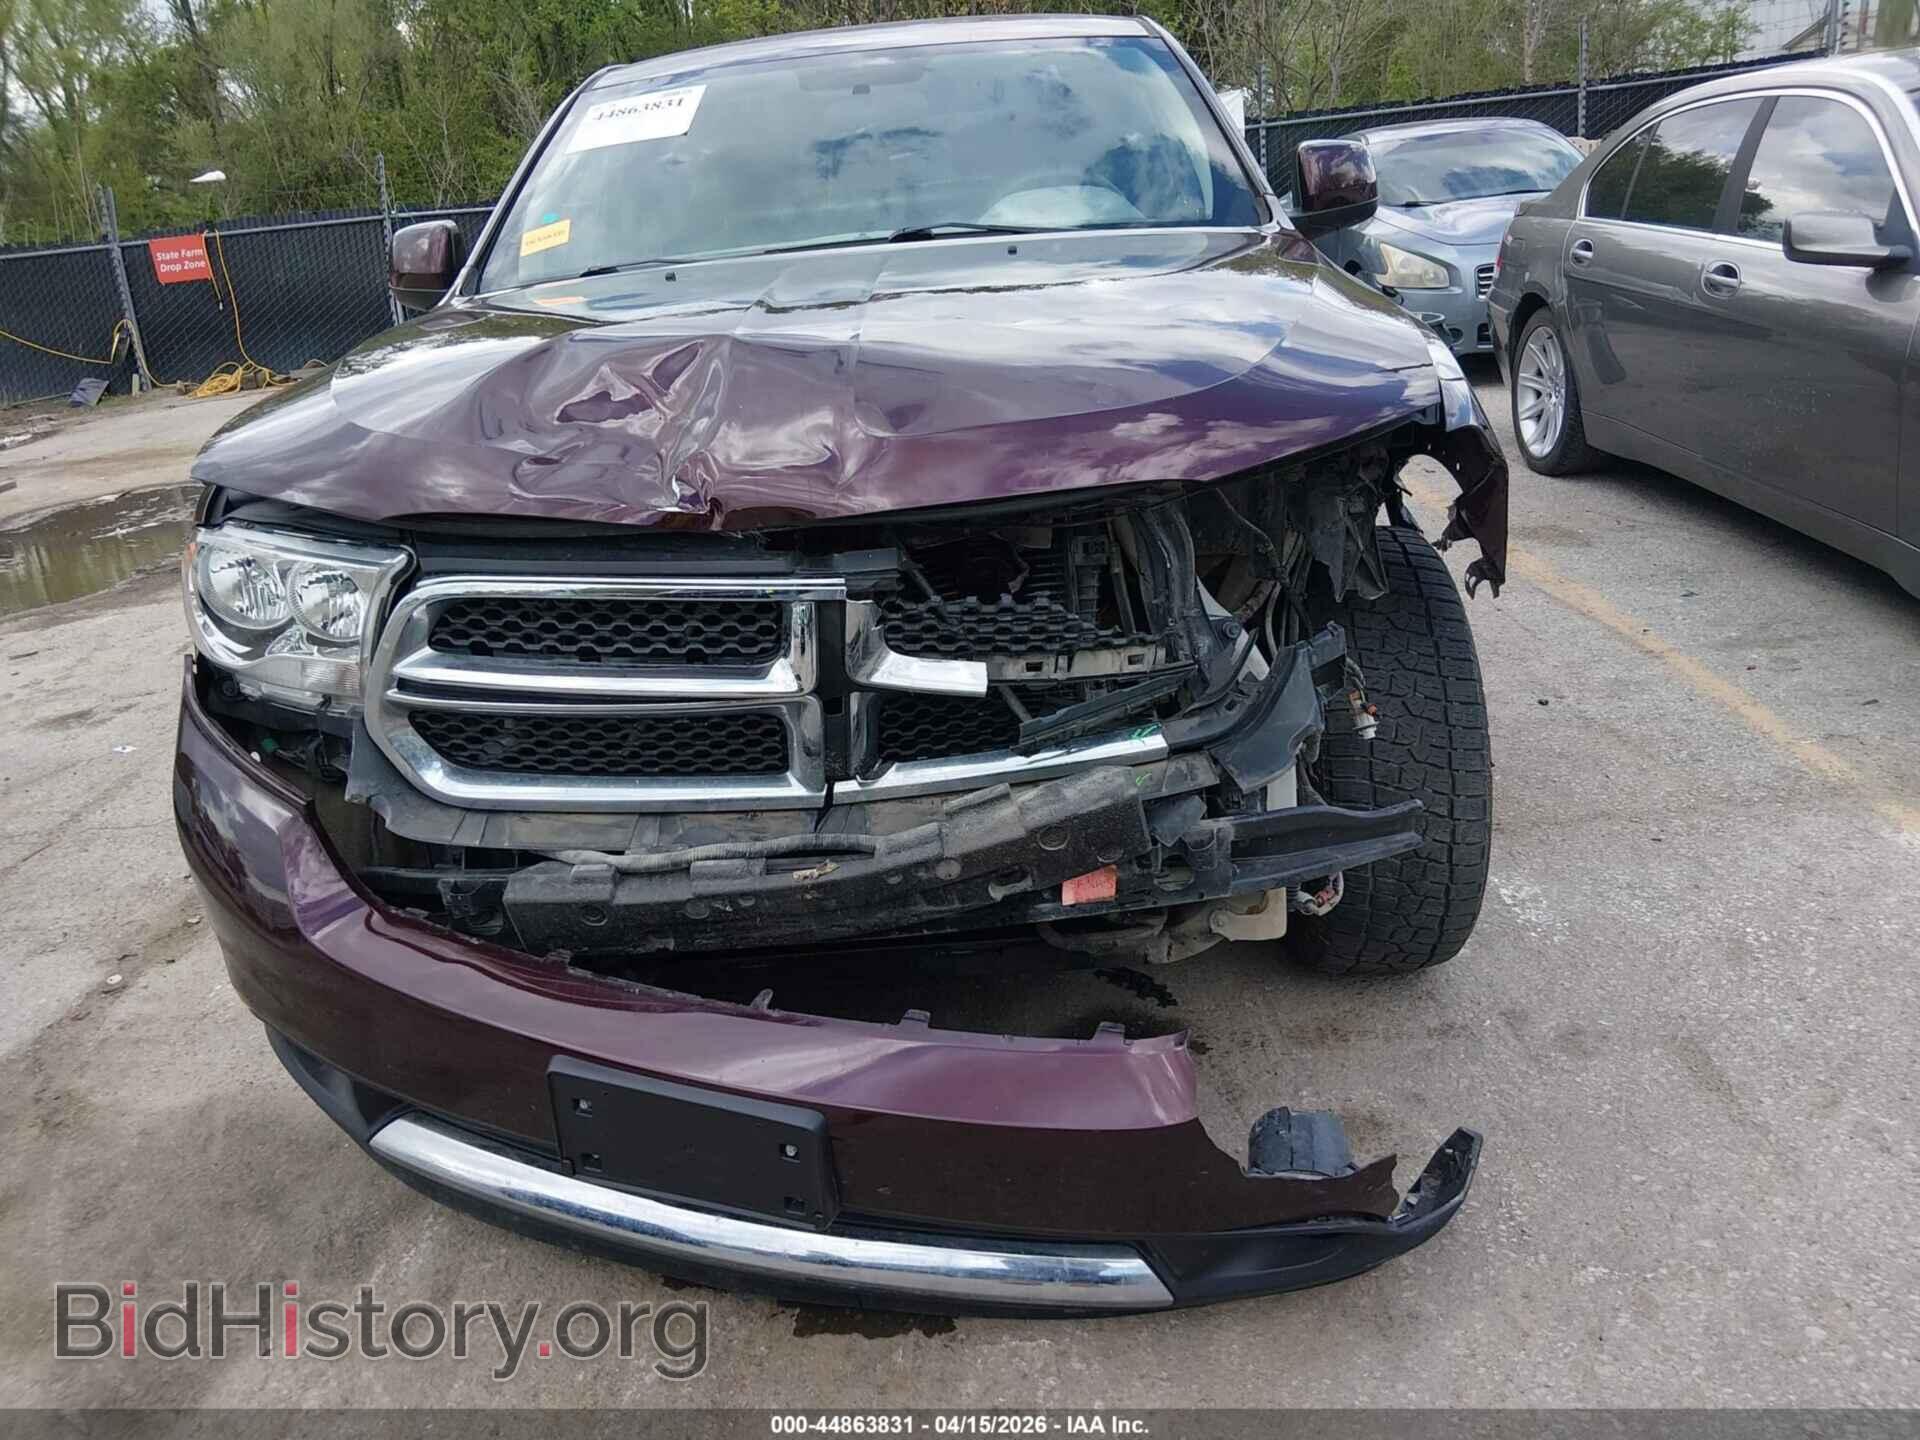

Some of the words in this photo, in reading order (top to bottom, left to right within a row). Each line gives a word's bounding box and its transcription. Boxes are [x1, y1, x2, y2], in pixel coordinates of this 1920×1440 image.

[156, 251, 179, 261] State
[180, 248, 203, 258] Farm
[160, 263, 182, 272] Drop
[183, 260, 206, 270] Zone
